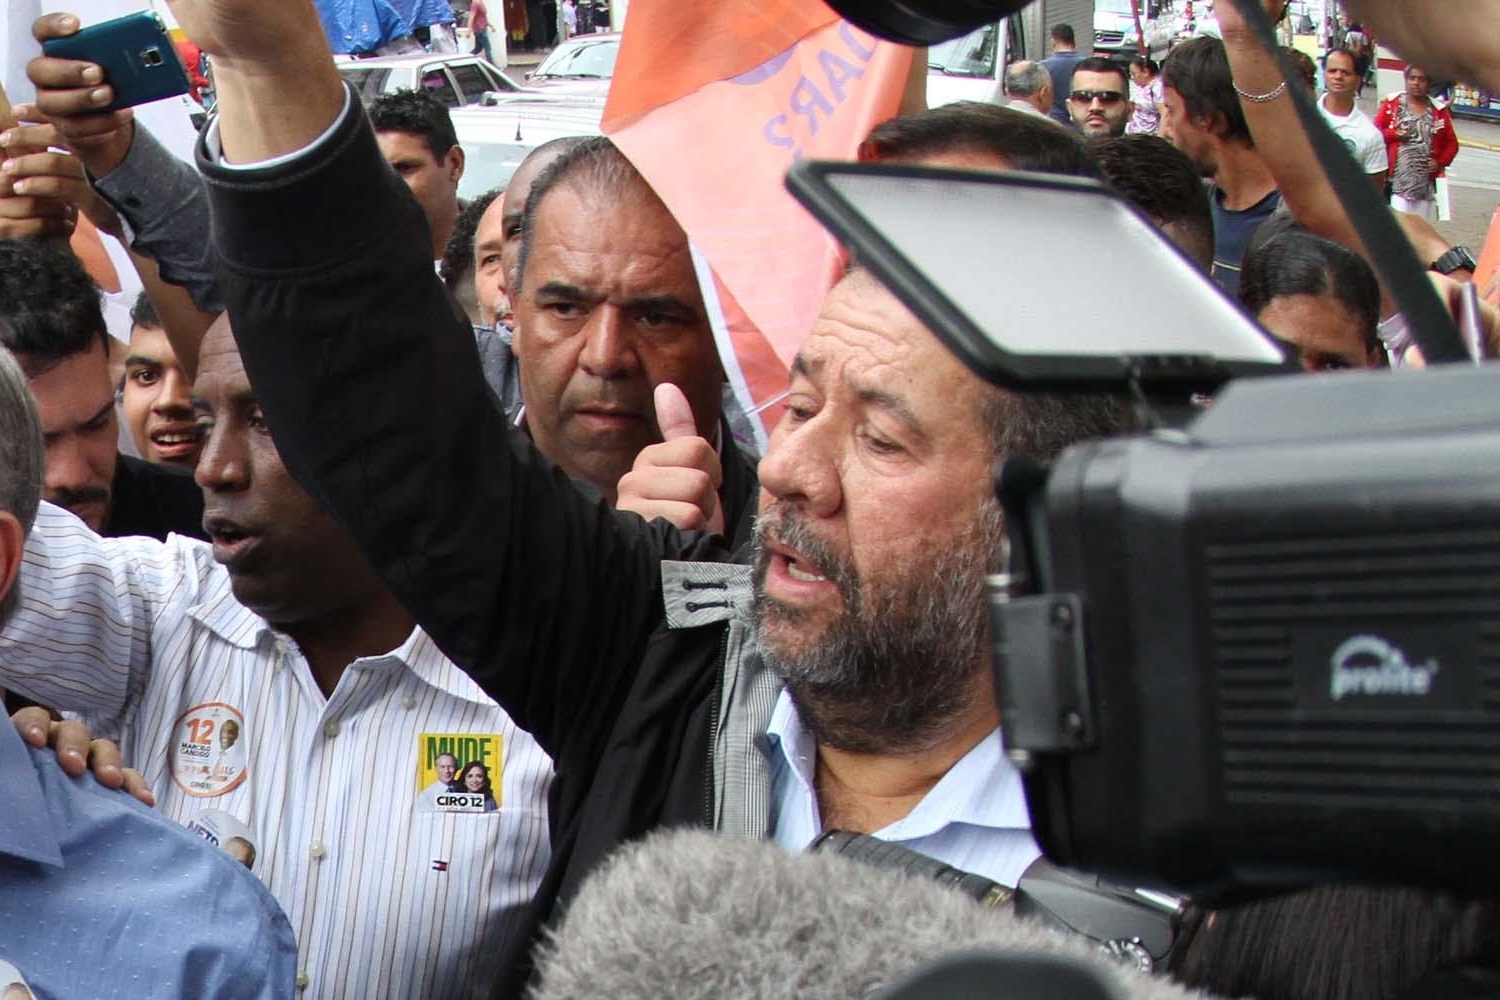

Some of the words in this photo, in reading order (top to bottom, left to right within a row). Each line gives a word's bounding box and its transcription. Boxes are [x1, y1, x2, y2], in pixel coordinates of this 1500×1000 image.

[1331, 640, 1432, 700] prolite
[186, 718, 215, 746] 12
[181, 742, 211, 752] MARCELO
[427, 736, 492, 771] MUDE
[436, 795, 468, 807] CIRO
[470, 797, 483, 808] 12
